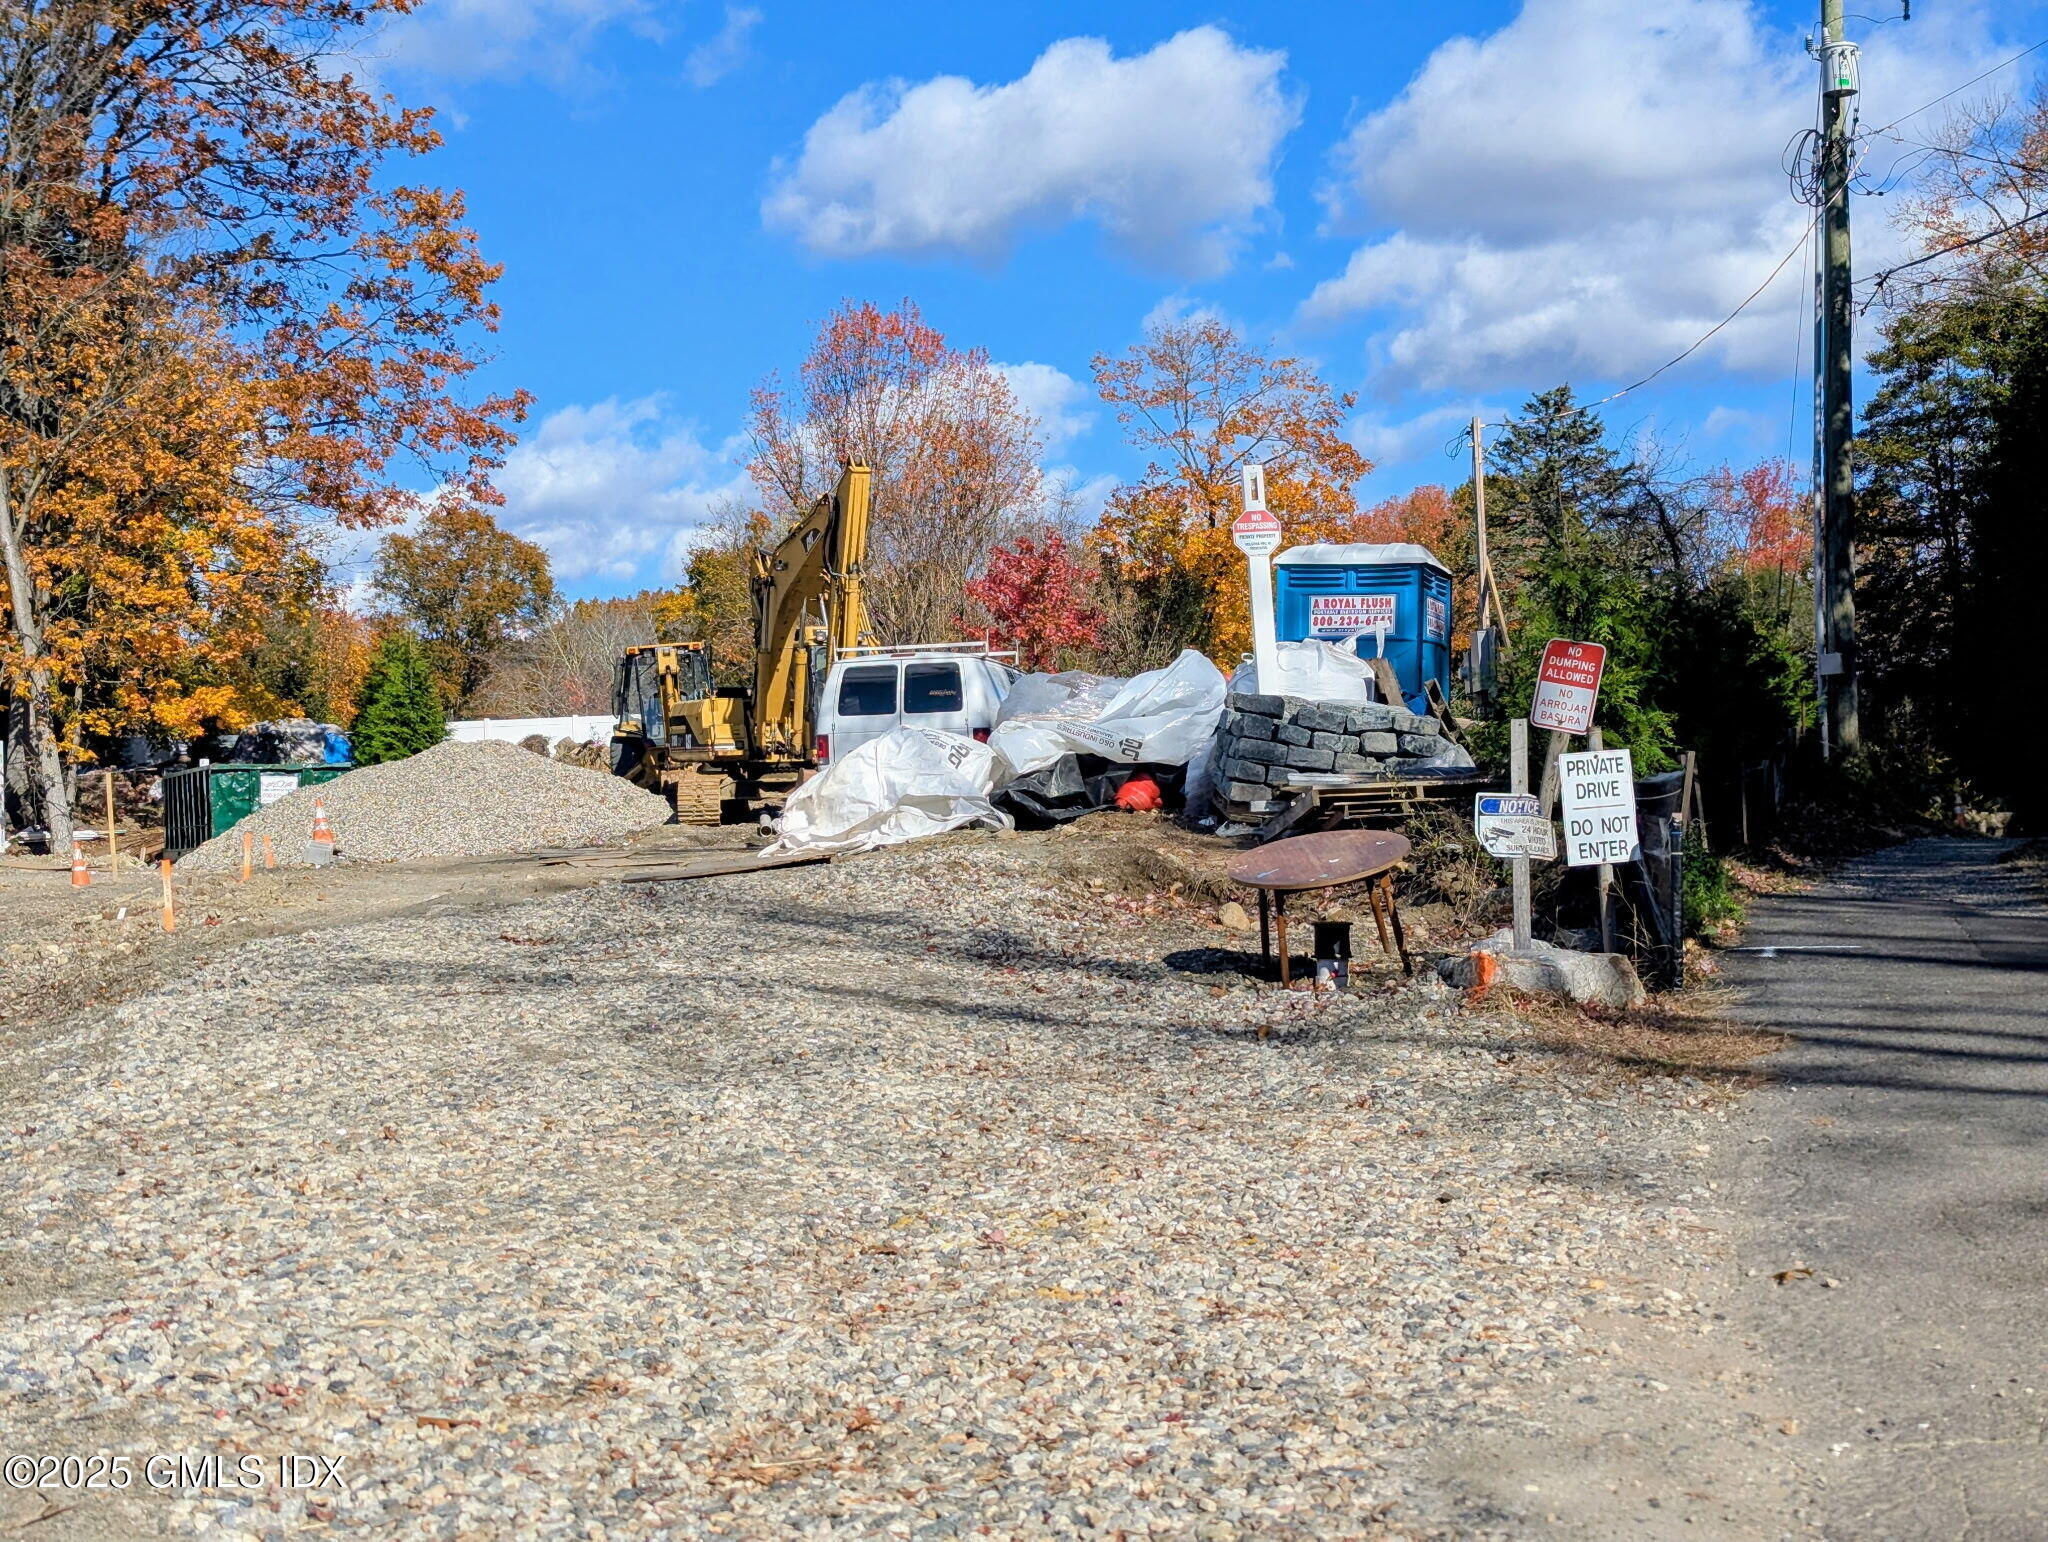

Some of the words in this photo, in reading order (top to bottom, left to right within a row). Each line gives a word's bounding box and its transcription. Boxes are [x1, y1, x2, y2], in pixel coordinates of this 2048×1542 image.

[1236, 521, 1278, 530] TRESPASSING
[1251, 513, 1262, 521] NO
[1313, 598, 1320, 609] A
[1323, 598, 1357, 609] ROYAL
[1360, 597, 1392, 608] FLUSH
[1567, 645, 1583, 657] NO
[1548, 655, 1596, 672] DUMPING
[1545, 667, 1594, 685] ALLOWED
[1558, 688, 1573, 700] NO
[1539, 698, 1588, 715] ARROJAR
[1540, 710, 1581, 727] BASURA
[1056, 723, 1099, 744] INDUSTRIES
[1566, 756, 1625, 777] PRIVATE
[1575, 780, 1621, 800] DRIVE
[1498, 799, 1540, 815] NOTICE
[1521, 826, 1531, 834] 24
[1571, 818, 1593, 837] DO
[1601, 815, 1631, 834] NOT
[1579, 839, 1629, 859] ENTER
